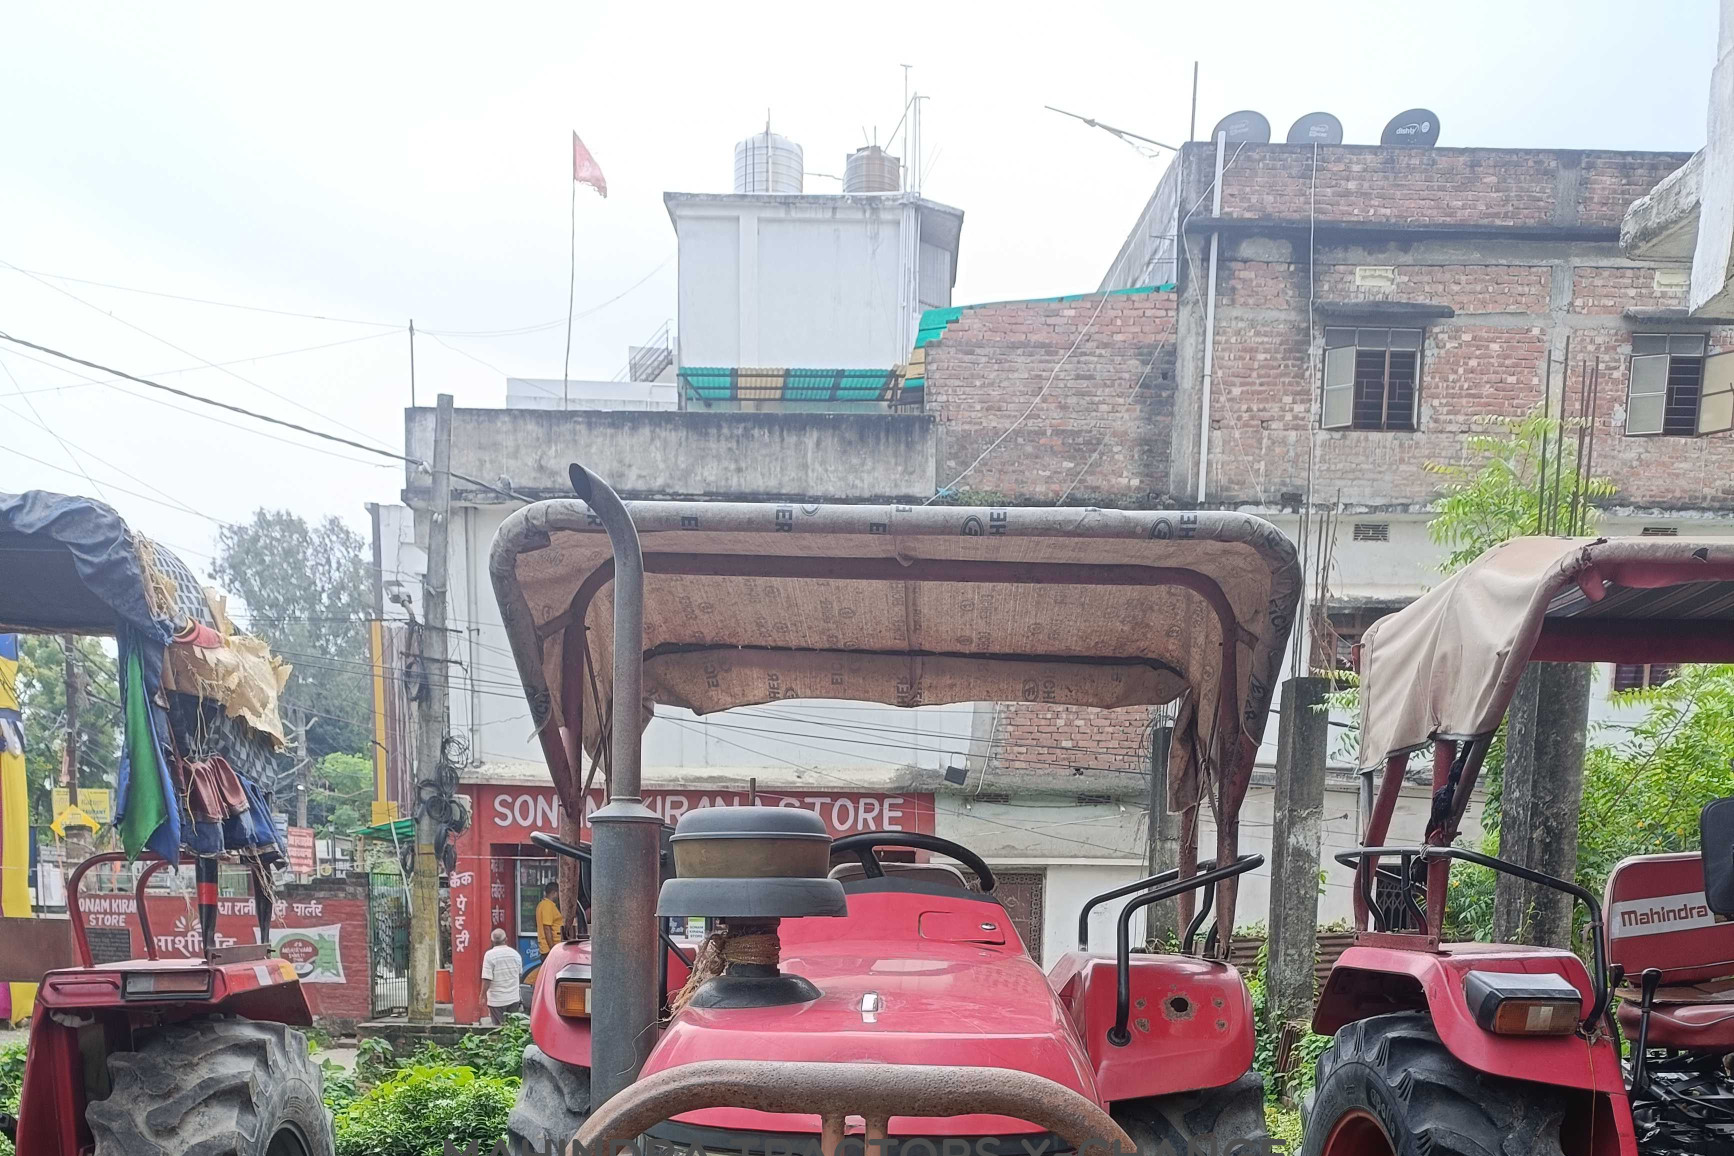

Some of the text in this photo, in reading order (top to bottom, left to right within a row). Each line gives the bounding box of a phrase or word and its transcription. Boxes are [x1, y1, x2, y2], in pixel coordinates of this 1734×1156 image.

[493, 794, 607, 829] SONM
[79, 898, 137, 913] ONAM KIRA
[89, 914, 126, 926] STORE
